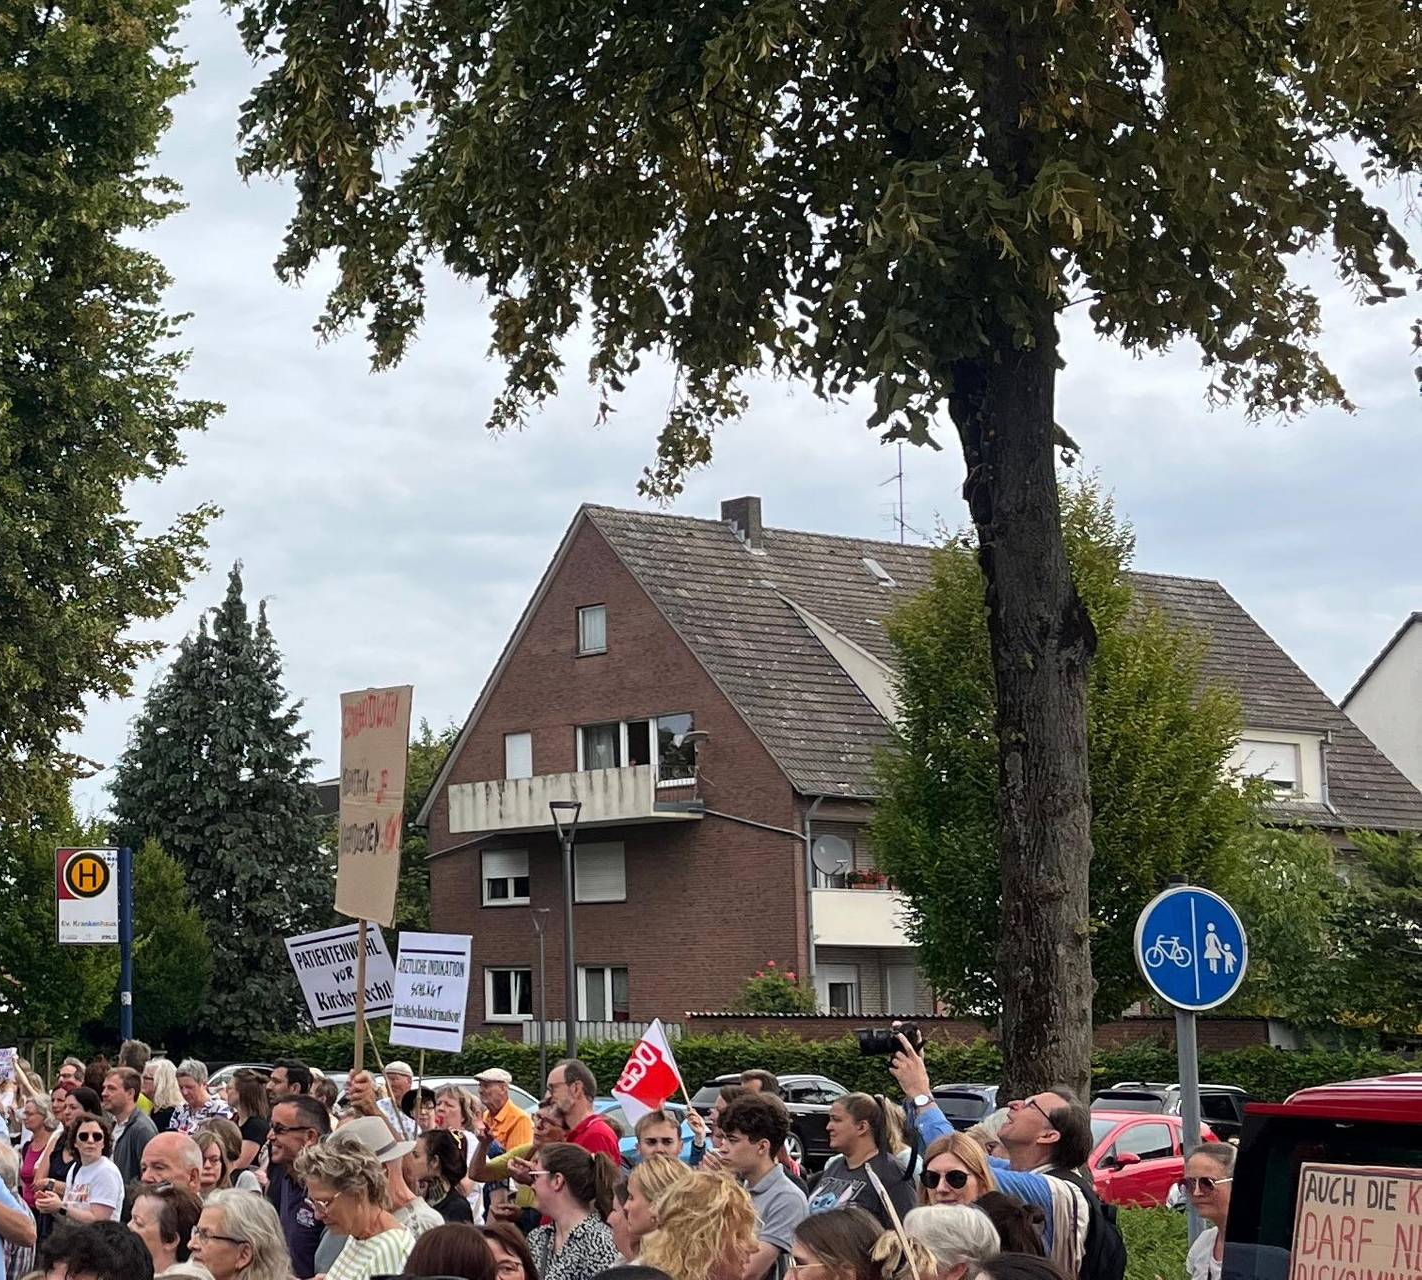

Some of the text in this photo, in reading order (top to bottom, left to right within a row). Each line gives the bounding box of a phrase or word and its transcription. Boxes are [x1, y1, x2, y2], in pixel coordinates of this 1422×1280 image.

[79, 863, 96, 888] H
[294, 938, 382, 970] PATIENTENWHL
[332, 966, 355, 984] VOR
[1305, 1173, 1356, 1207] AUCH
[1366, 1180, 1398, 1211] DIE
[1301, 1211, 1375, 1263] DARF
